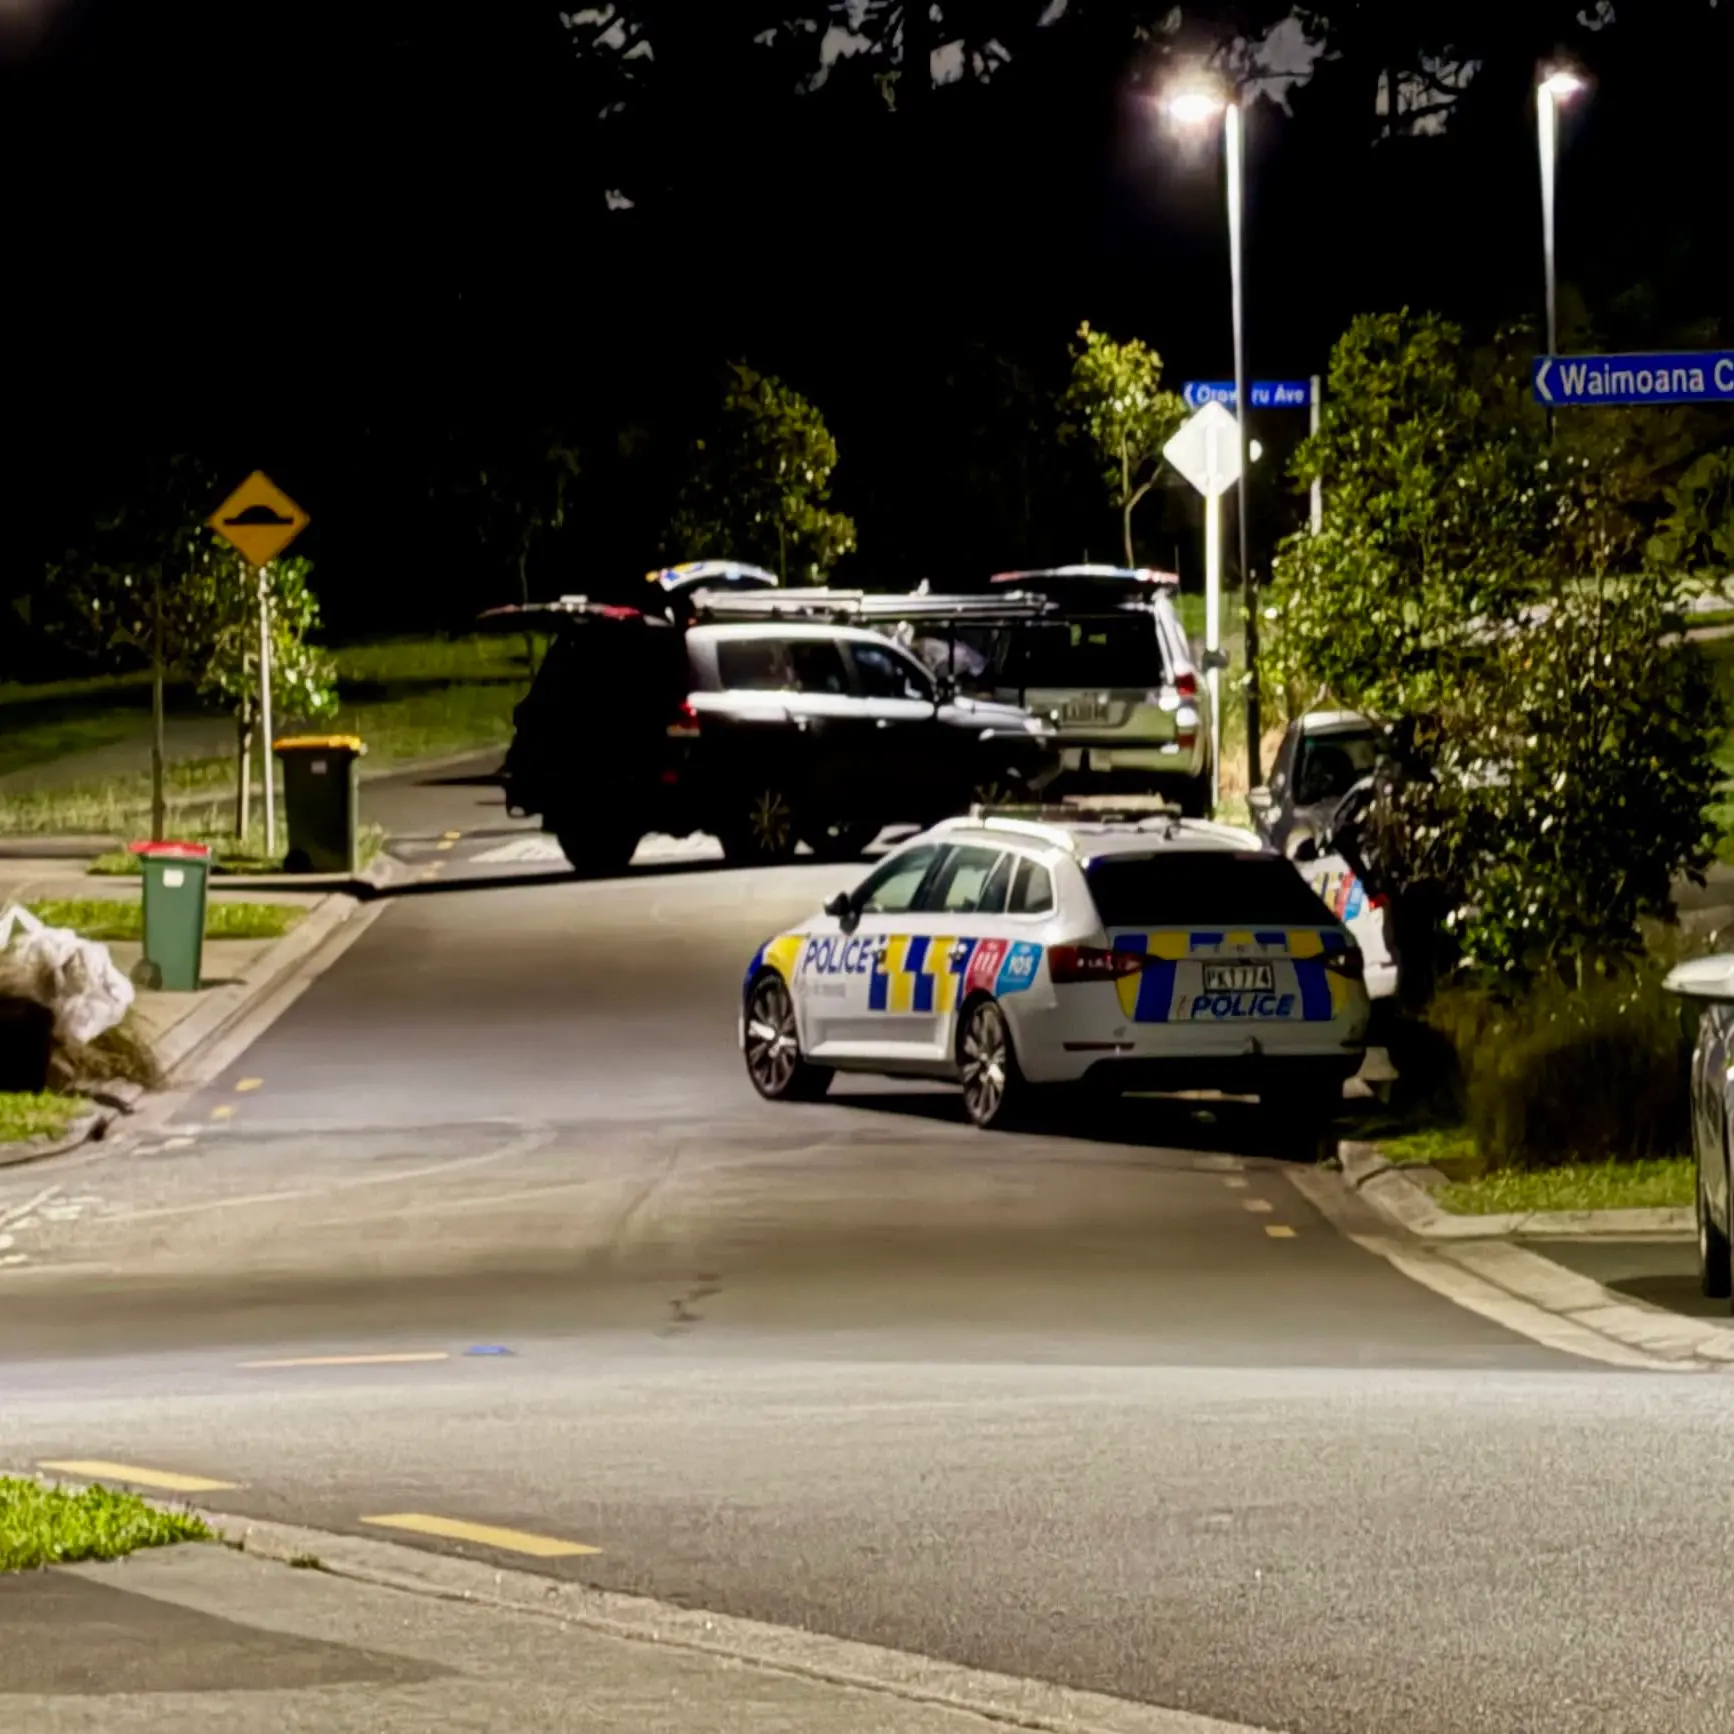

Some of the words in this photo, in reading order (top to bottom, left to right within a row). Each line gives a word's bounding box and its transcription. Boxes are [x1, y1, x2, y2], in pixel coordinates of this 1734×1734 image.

[1559, 362, 1705, 397] Waimoana
[1274, 384, 1305, 404] Ave
[801, 936, 874, 974] POLICE
[973, 951, 999, 974] 111
[1190, 993, 1296, 1019] POLICE
